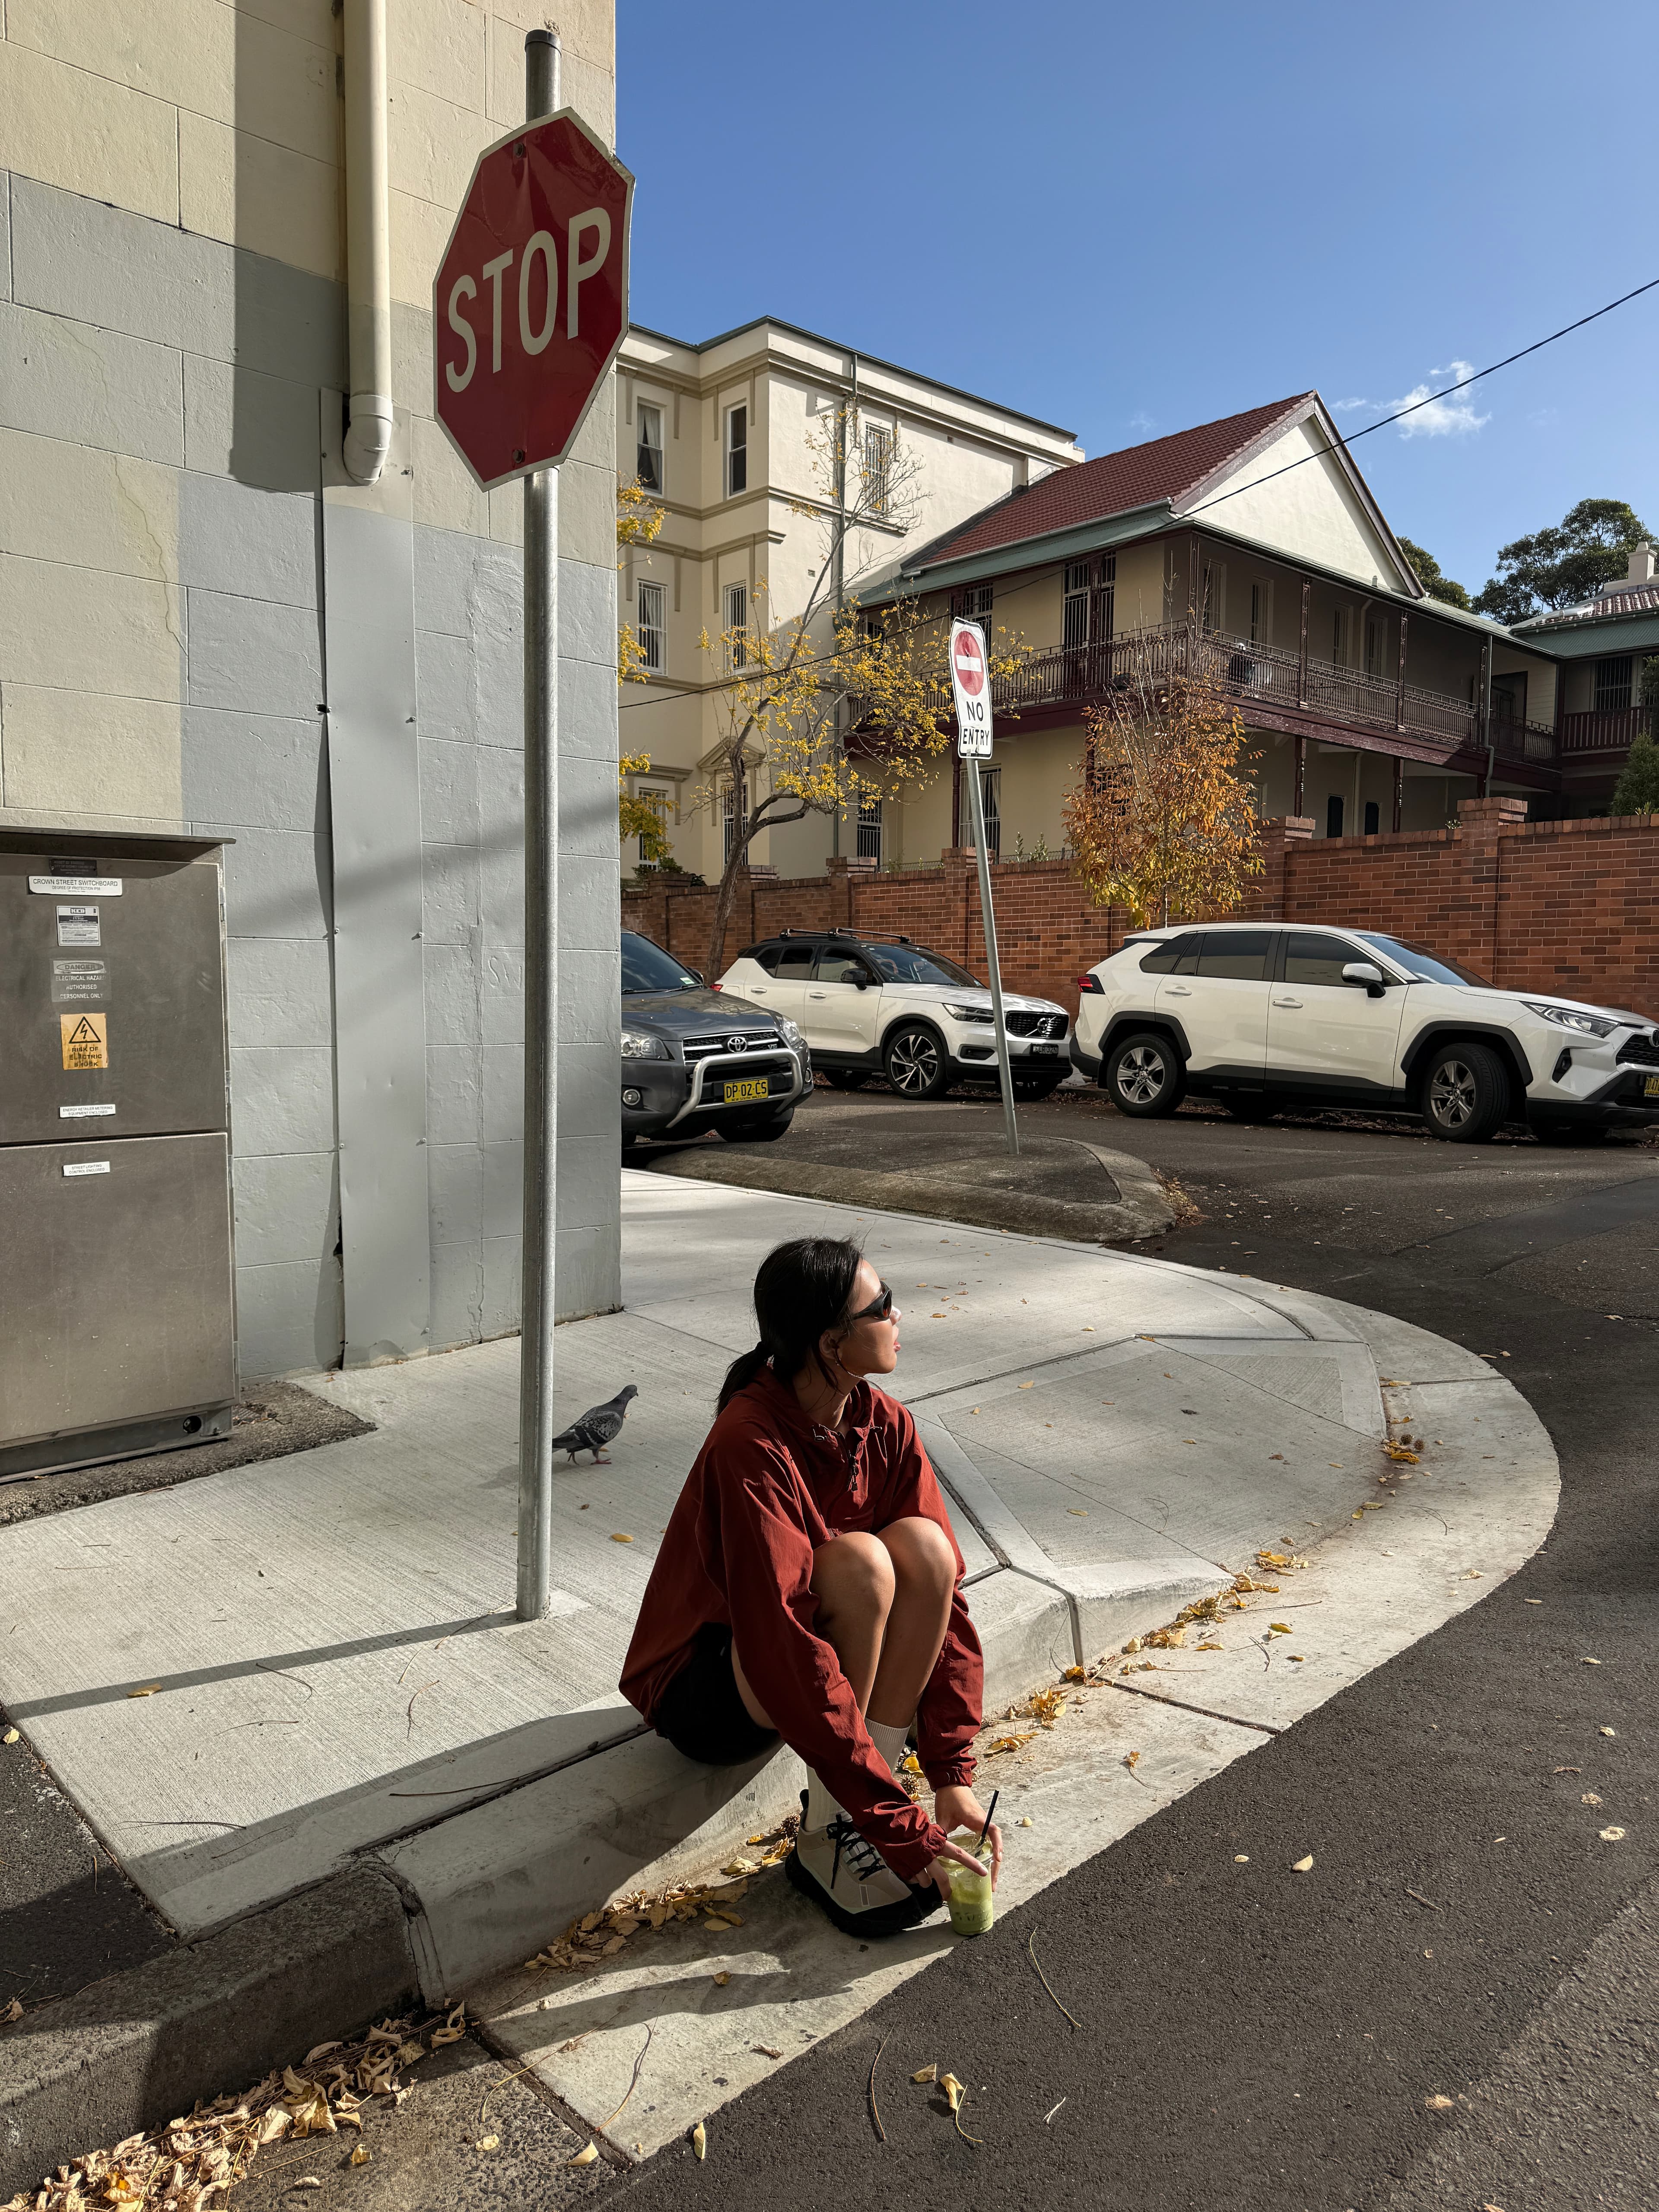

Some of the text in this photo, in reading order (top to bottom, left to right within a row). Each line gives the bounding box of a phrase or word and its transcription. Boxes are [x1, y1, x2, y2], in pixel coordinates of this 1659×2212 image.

[445, 207, 611, 393] STOP
[966, 701, 983, 721] NO
[963, 728, 989, 746] ENTRY
